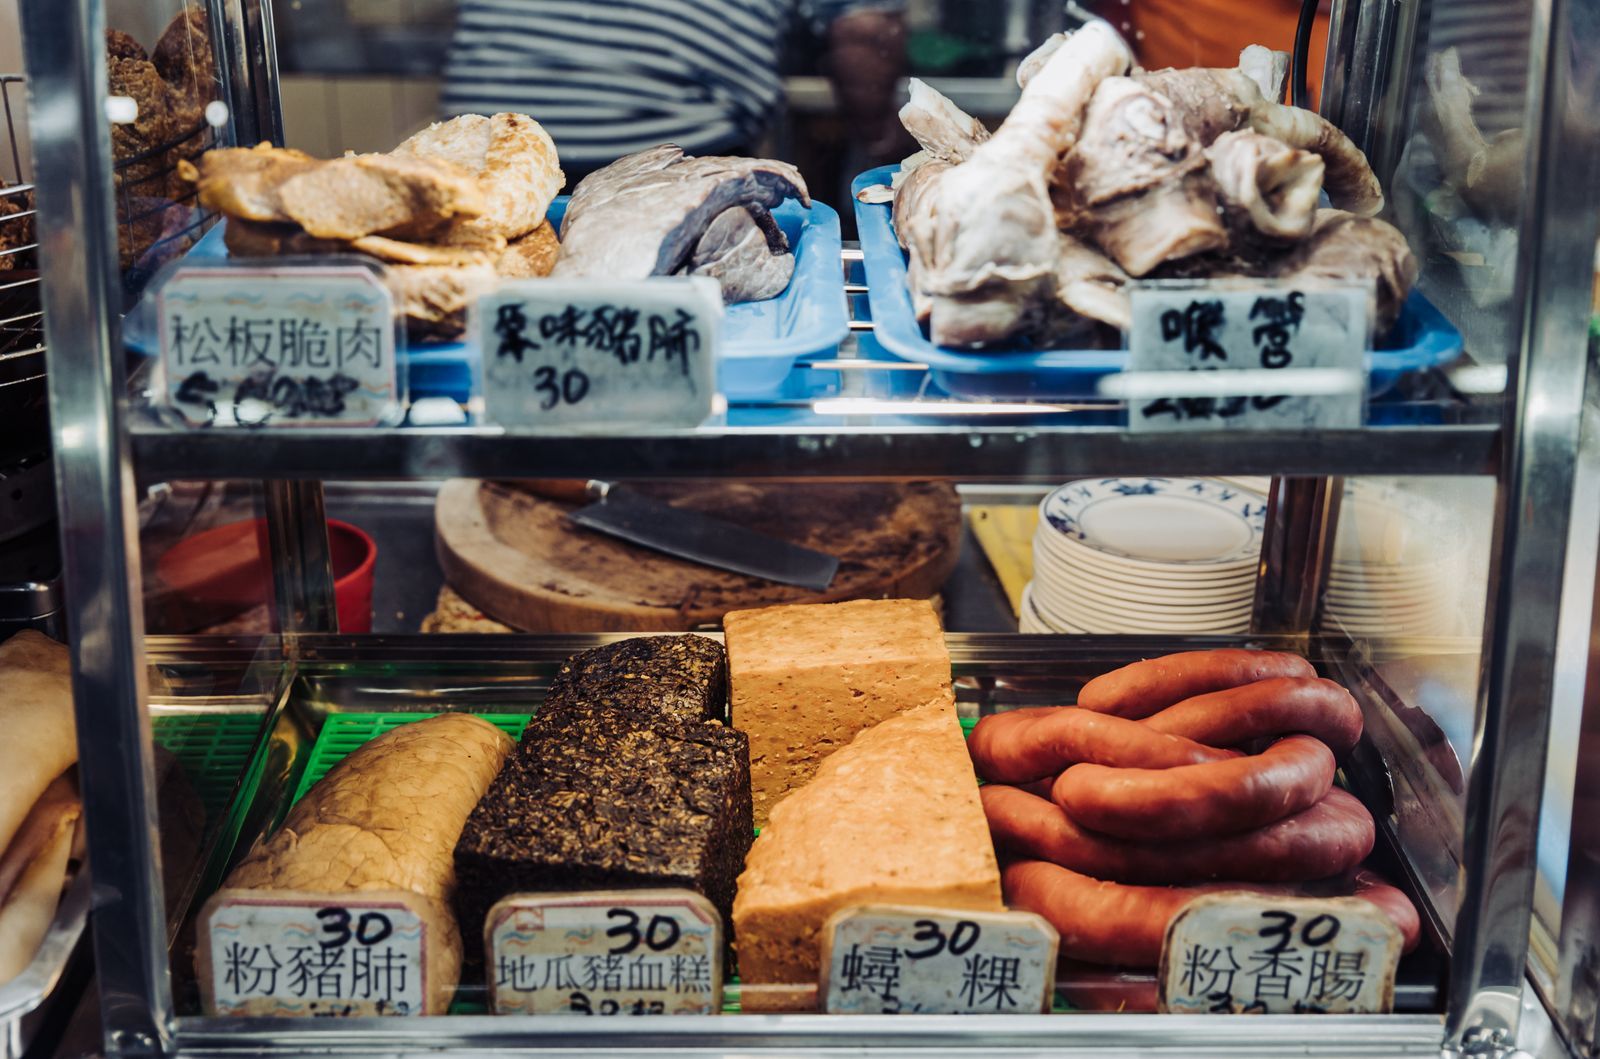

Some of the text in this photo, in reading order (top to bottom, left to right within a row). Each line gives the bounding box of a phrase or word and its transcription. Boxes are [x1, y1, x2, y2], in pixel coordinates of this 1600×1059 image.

[171, 314, 382, 369] 松板脆肉
[534, 366, 590, 410] 30
[316, 907, 393, 949] 30
[607, 908, 681, 955] 30
[904, 920, 981, 959] 30
[1259, 911, 1340, 953] 30
[224, 941, 408, 1002] 粉豬肺
[496, 954, 712, 993] 地瓜豬血糕
[1180, 944, 1366, 1001] 粉香腸
